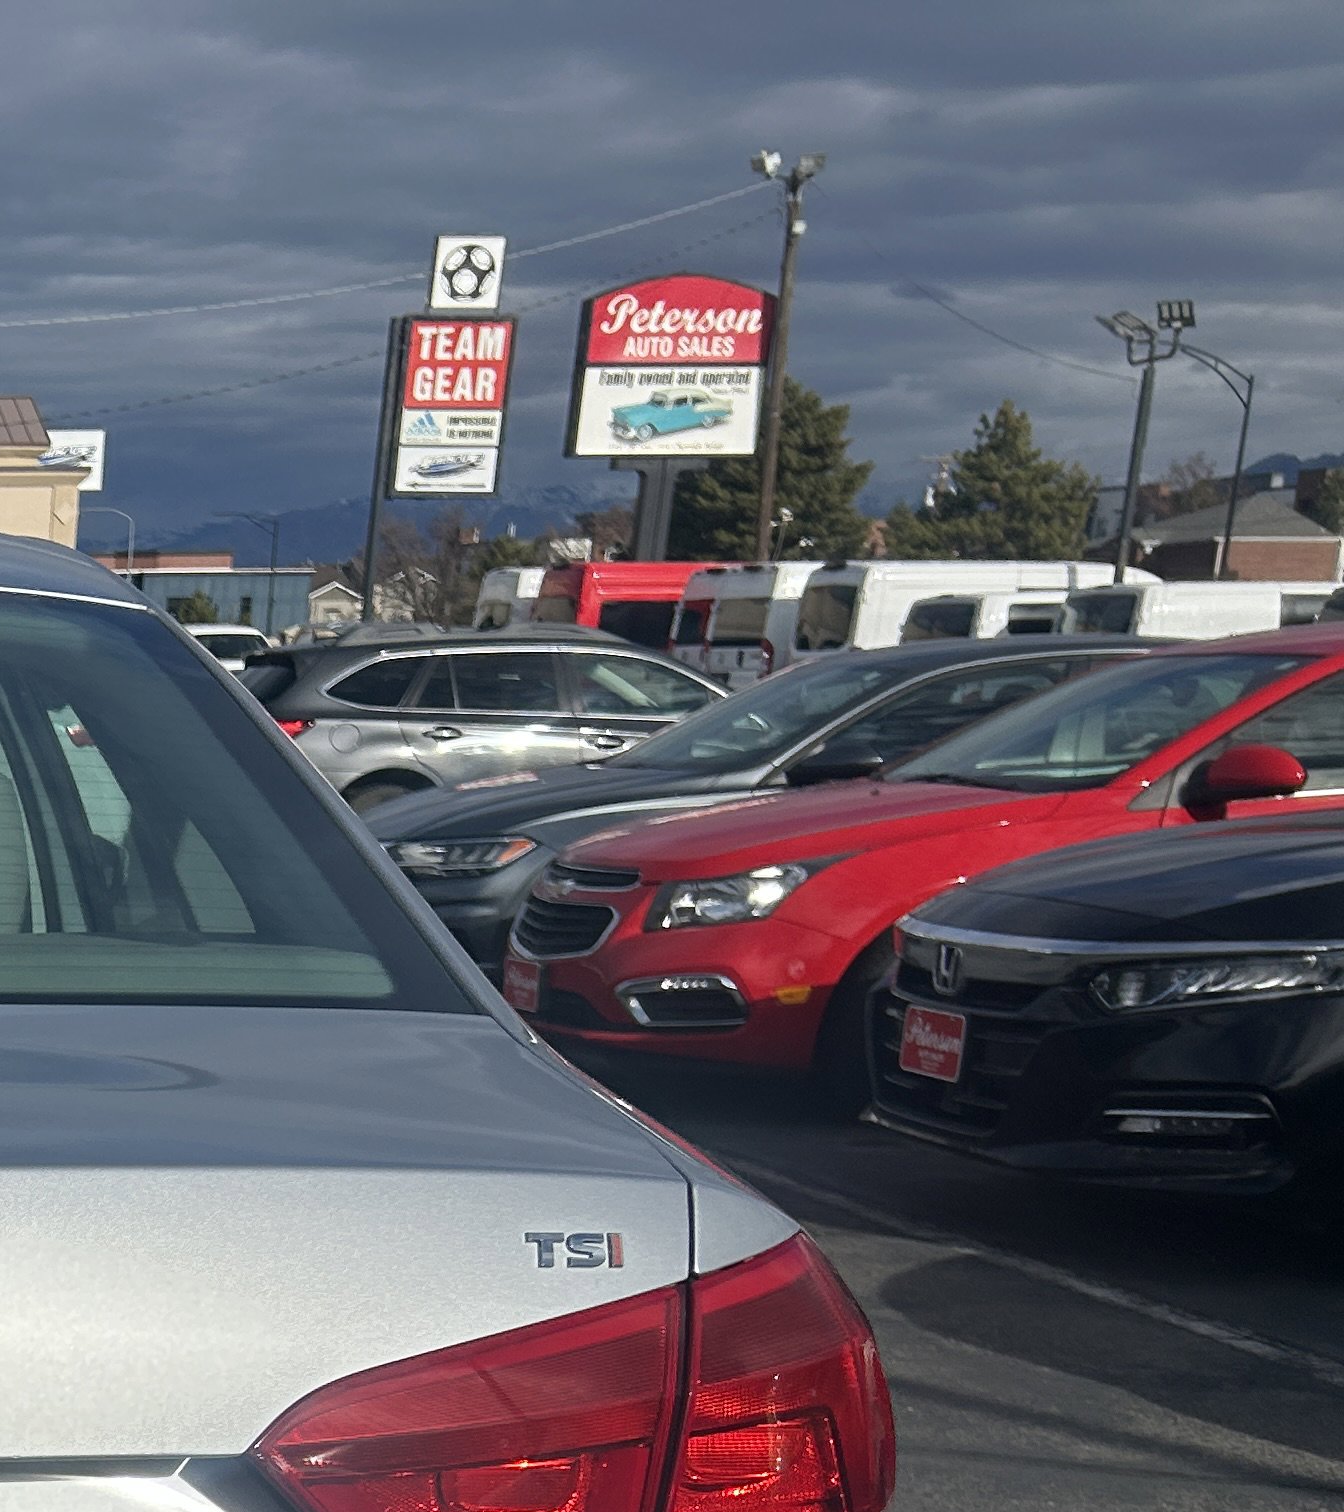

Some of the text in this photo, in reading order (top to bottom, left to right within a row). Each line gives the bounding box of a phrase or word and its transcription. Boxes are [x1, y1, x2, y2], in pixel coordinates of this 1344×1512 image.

[600, 293, 763, 335] Peterson
[417, 326, 506, 361] TEAM
[623, 336, 735, 357] AUTO SALES
[413, 366, 497, 401] GEAR
[524, 1232, 624, 1269] TSI
